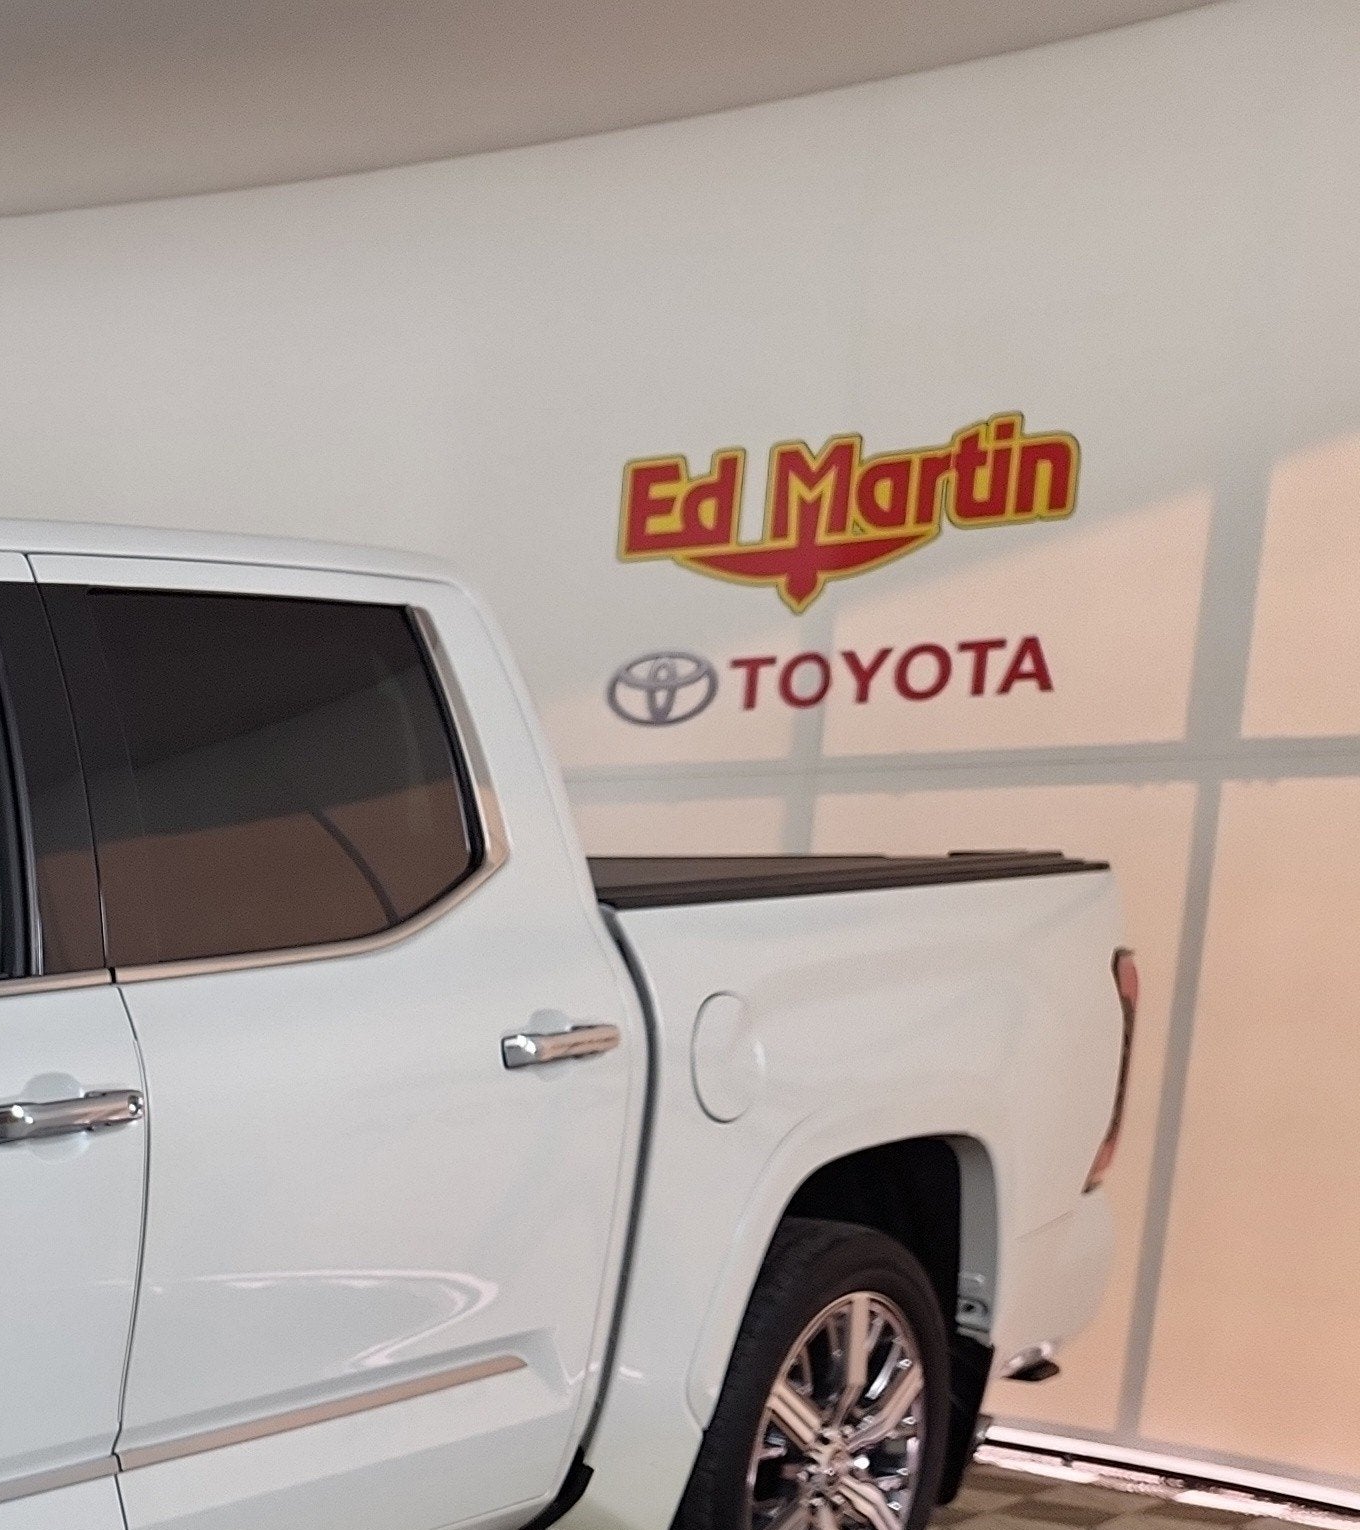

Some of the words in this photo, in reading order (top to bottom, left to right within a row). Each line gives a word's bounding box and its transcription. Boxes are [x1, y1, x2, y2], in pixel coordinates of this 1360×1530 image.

[622, 452, 741, 555] Ed
[768, 416, 1076, 541] Martin
[730, 634, 1054, 711] TOYOTA
